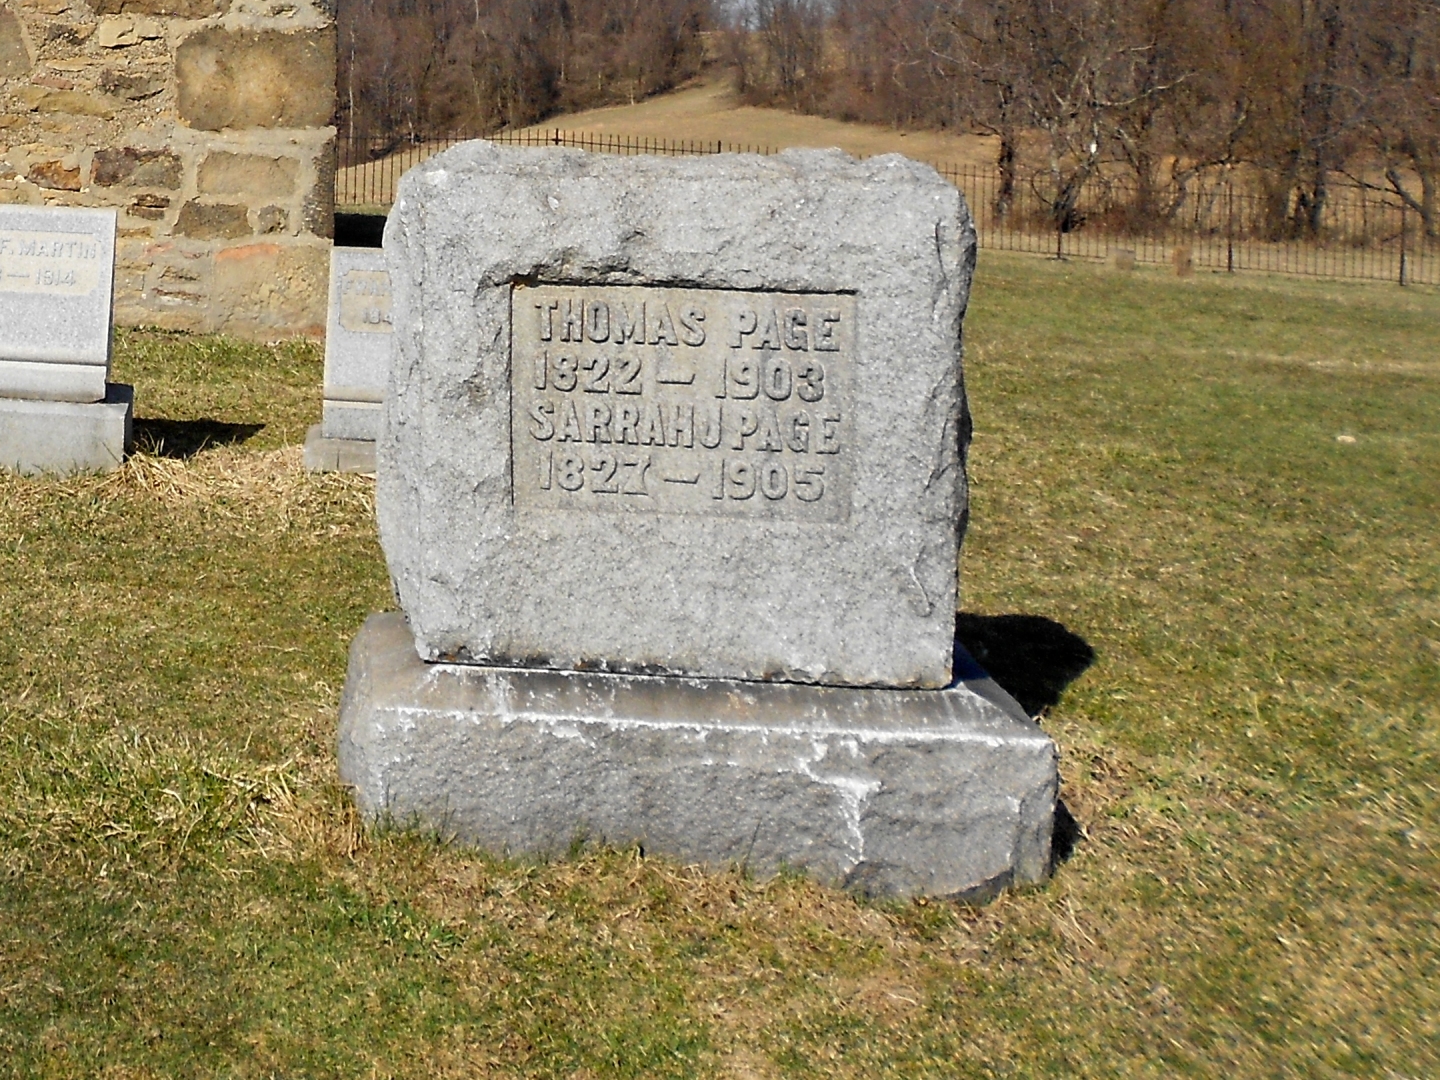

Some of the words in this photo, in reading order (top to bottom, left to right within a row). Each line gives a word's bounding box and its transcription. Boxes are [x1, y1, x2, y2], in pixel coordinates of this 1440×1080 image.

[18, 239, 98, 260] MARTIN
[534, 298, 707, 348] THOMAS
[729, 307, 842, 353] PAGE
[533, 349, 643, 396] 1822
[714, 356, 825, 403] 1903
[529, 399, 695, 450] SARRAH
[731, 409, 843, 456] PAGE
[539, 450, 652, 497] 1827
[712, 457, 826, 504] 1905
